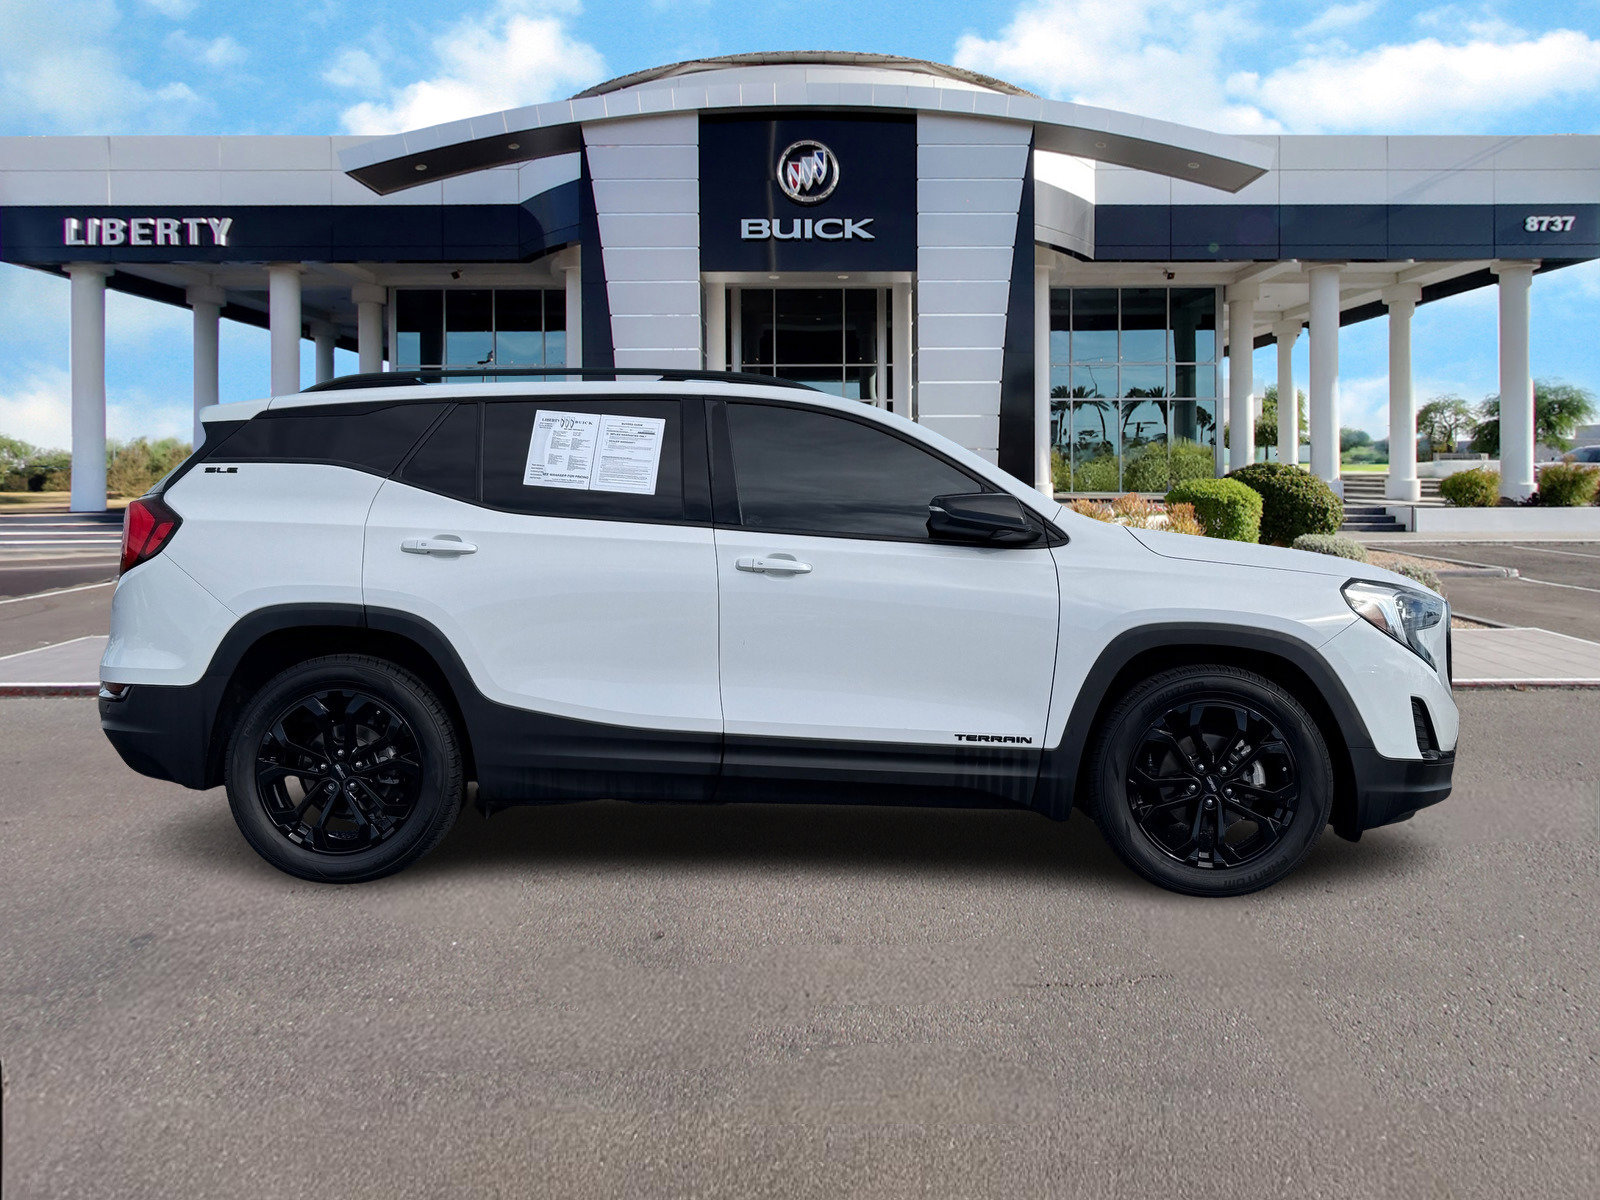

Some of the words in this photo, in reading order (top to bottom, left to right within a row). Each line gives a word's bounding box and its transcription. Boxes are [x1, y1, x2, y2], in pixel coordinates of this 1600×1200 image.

[64, 217, 233, 246] LIBERTY
[740, 218, 876, 239] BUICK
[1525, 215, 1576, 231] 8737
[954, 733, 1033, 744] TERRAIN
